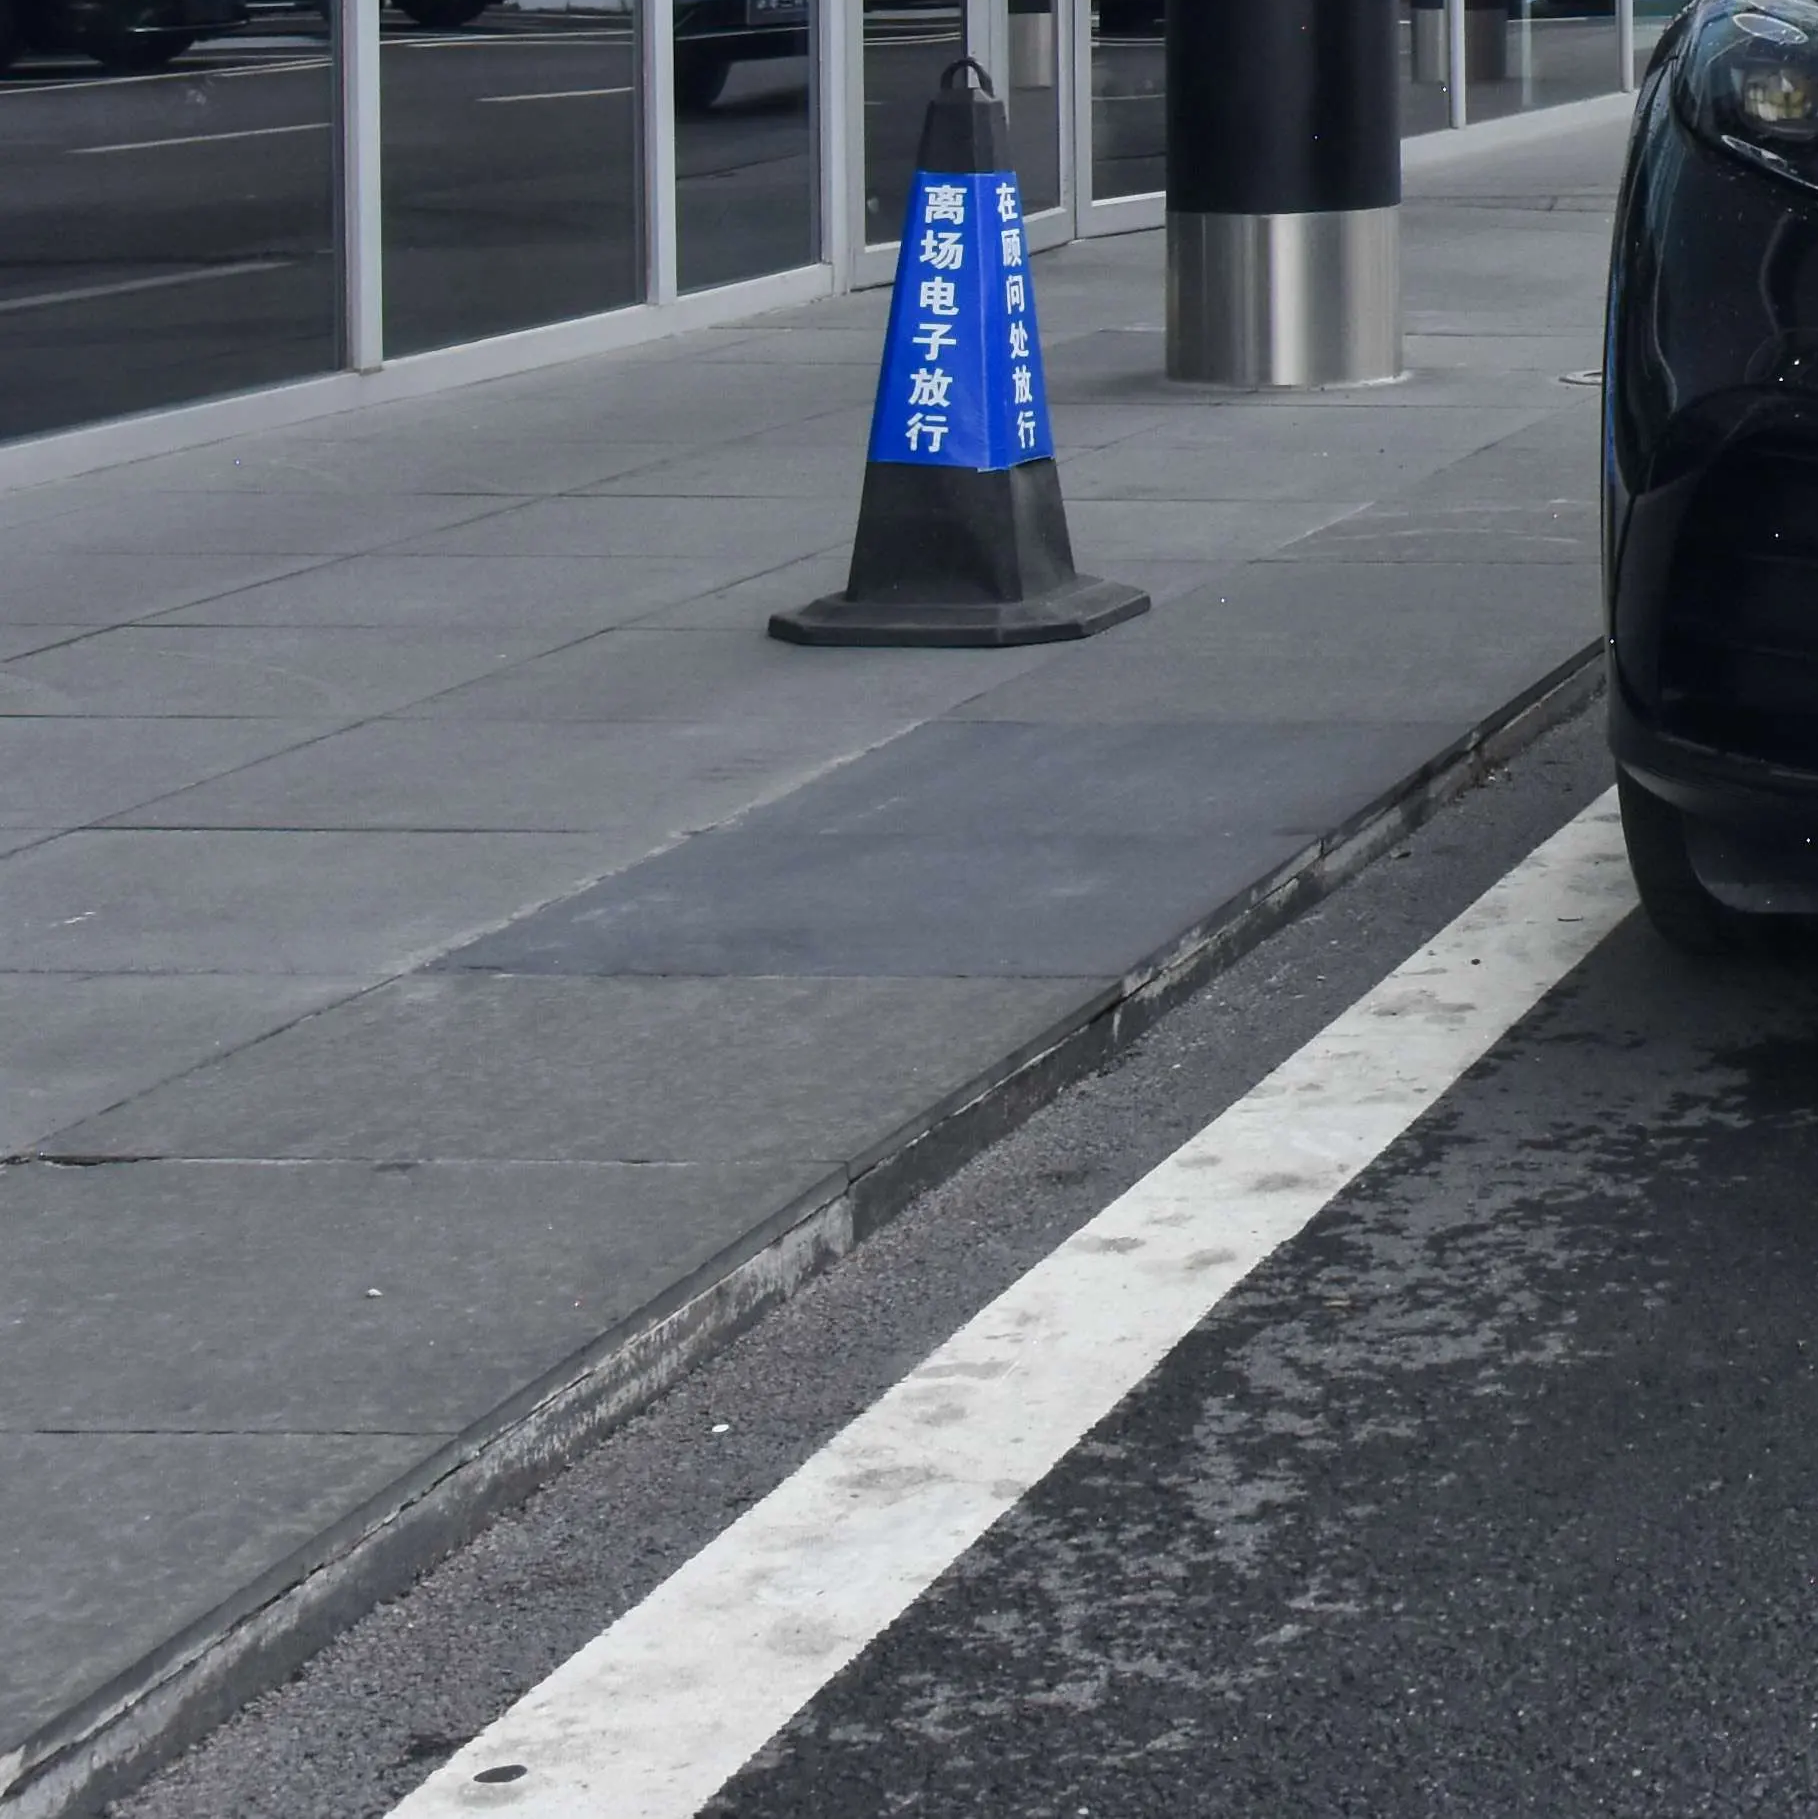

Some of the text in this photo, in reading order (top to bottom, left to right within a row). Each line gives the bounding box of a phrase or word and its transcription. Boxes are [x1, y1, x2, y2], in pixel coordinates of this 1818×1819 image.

[906, 184, 967, 453] 离场电子放行
[996, 182, 1037, 449] 在顾问处放行
